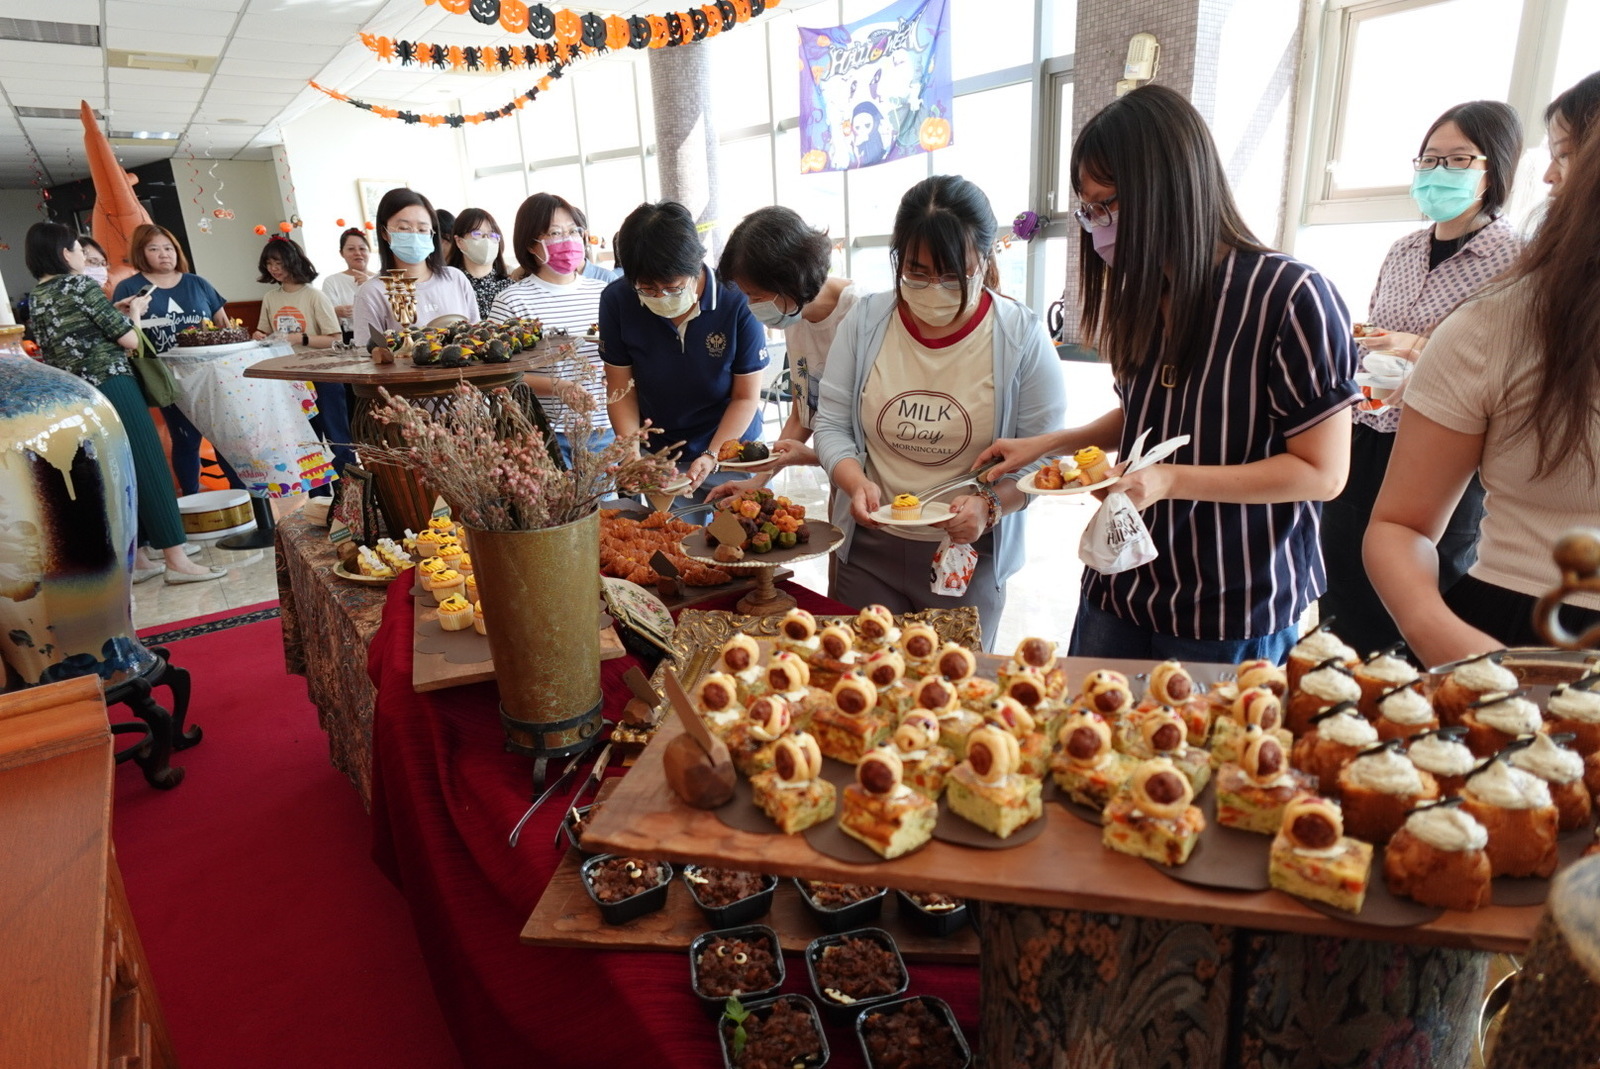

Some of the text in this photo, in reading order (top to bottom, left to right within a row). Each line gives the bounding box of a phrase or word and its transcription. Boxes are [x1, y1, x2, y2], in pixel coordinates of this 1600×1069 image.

[149, 312, 202, 333] lifornia
[898, 399, 952, 422] MILK
[896, 421, 944, 445] Day
